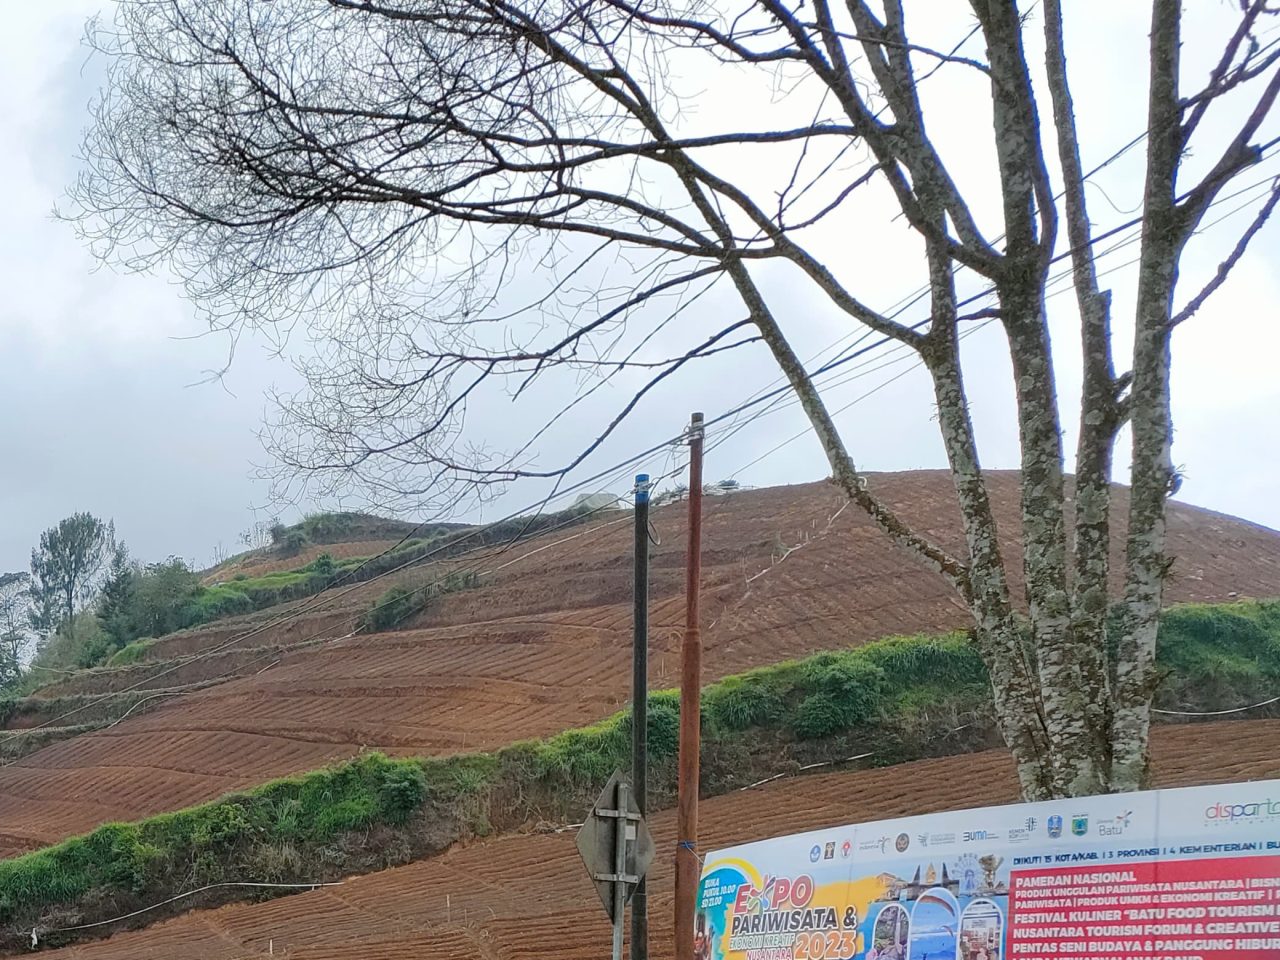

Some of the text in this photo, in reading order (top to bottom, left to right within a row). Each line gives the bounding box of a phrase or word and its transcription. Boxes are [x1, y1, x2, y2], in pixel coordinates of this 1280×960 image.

[1117, 848, 1159, 858] PROVINSI
[1015, 871, 1137, 888] PAMERAN NASIONAL
[1015, 888, 1052, 899] PRODUK
[1053, 886, 1105, 897] UNGGULAN
[1106, 882, 1172, 893] PARIWISATA
[1173, 880, 1245, 891] NUSANTARA
[1015, 898, 1072, 909] PARIWISATA
[1077, 897, 1119, 906] PRODUK
[1120, 894, 1151, 905] UMKM
[1152, 895, 1160, 904] &
[1161, 893, 1213, 903] EKONOMI
[1214, 891, 1265, 901] KREATIF
[732, 906, 856, 935] PARIWISATA &
[1014, 911, 1068, 924] FESTIVAL
[1069, 909, 1122, 922] KULINER
[1167, 907, 1207, 919] FOOD
[1208, 905, 1275, 918] TOURISM
[1013, 926, 1085, 939] NUSANTARA
[1086, 924, 1143, 937] TOURISM
[1144, 923, 1193, 936] FORUM
[1194, 923, 1204, 934] &
[729, 933, 764, 951] EKONOMI
[1012, 942, 1058, 954] PENTAS
[1060, 941, 1086, 953] SENI
[1088, 940, 1142, 952] BUDAYA
[1144, 940, 1153, 951] &
[1155, 939, 1233, 951] PANGGUNG
